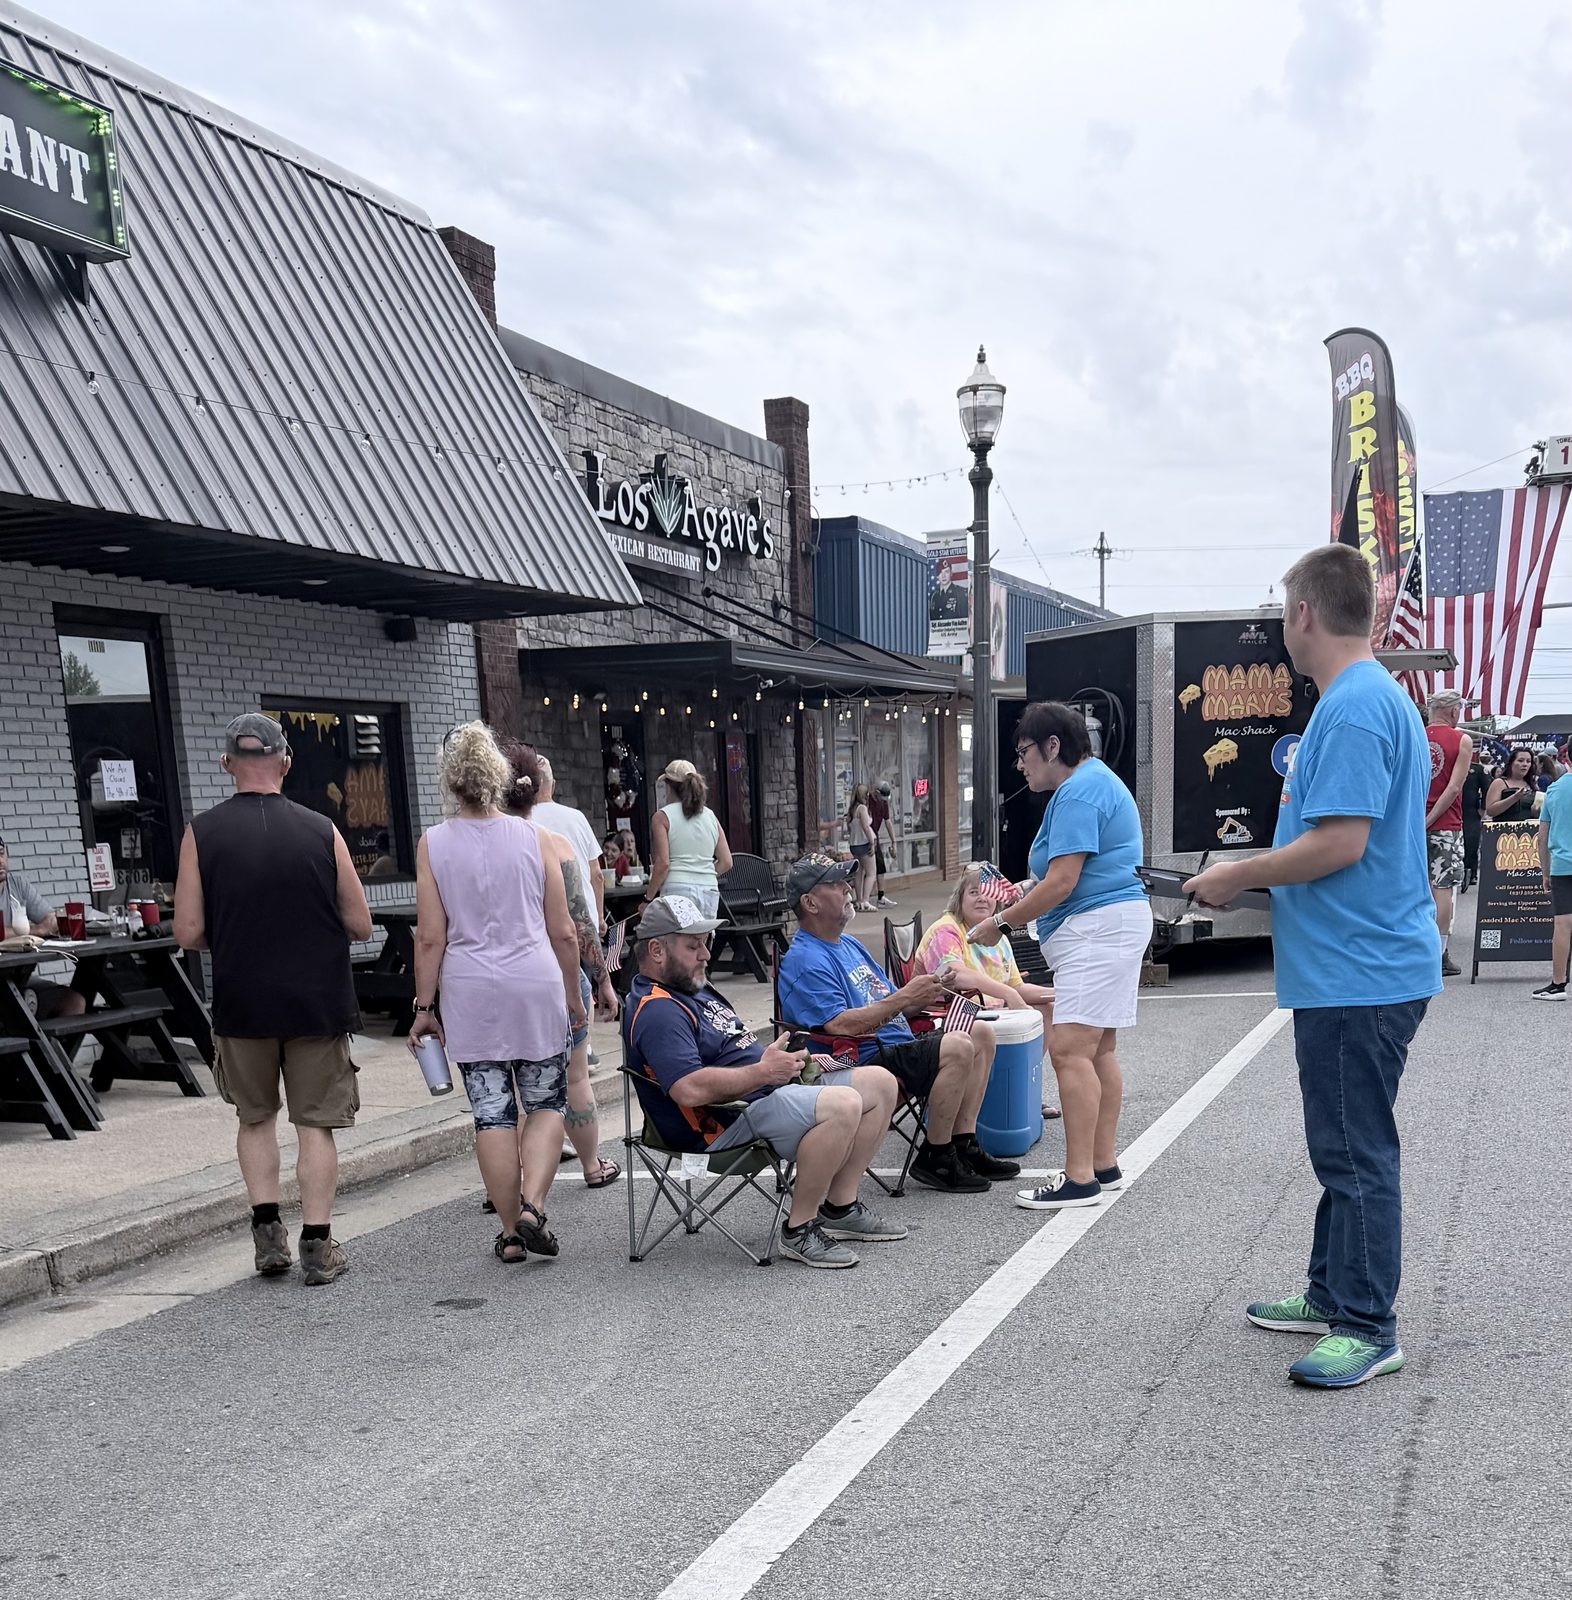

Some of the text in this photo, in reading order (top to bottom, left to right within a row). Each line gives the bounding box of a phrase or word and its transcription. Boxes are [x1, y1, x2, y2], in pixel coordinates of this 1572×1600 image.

[1335, 352, 1375, 400] BBQ
[1556, 437, 1572, 445] TOWE
[1347, 390, 1380, 576] BRISK
[594, 450, 774, 572] Los Agave's
[647, 543, 701, 573] RESTAURANT
[950, 547, 967, 555] VETERAN
[1203, 664, 1292, 691] MAMA
[1203, 692, 1292, 718] MARY'S
[1215, 724, 1277, 737] Mac Shack
[1216, 808, 1240, 818] Sponsored
[1497, 833, 1540, 850] MA
[1496, 851, 1541, 868] MAR
[1527, 870, 1542, 878] Sha
